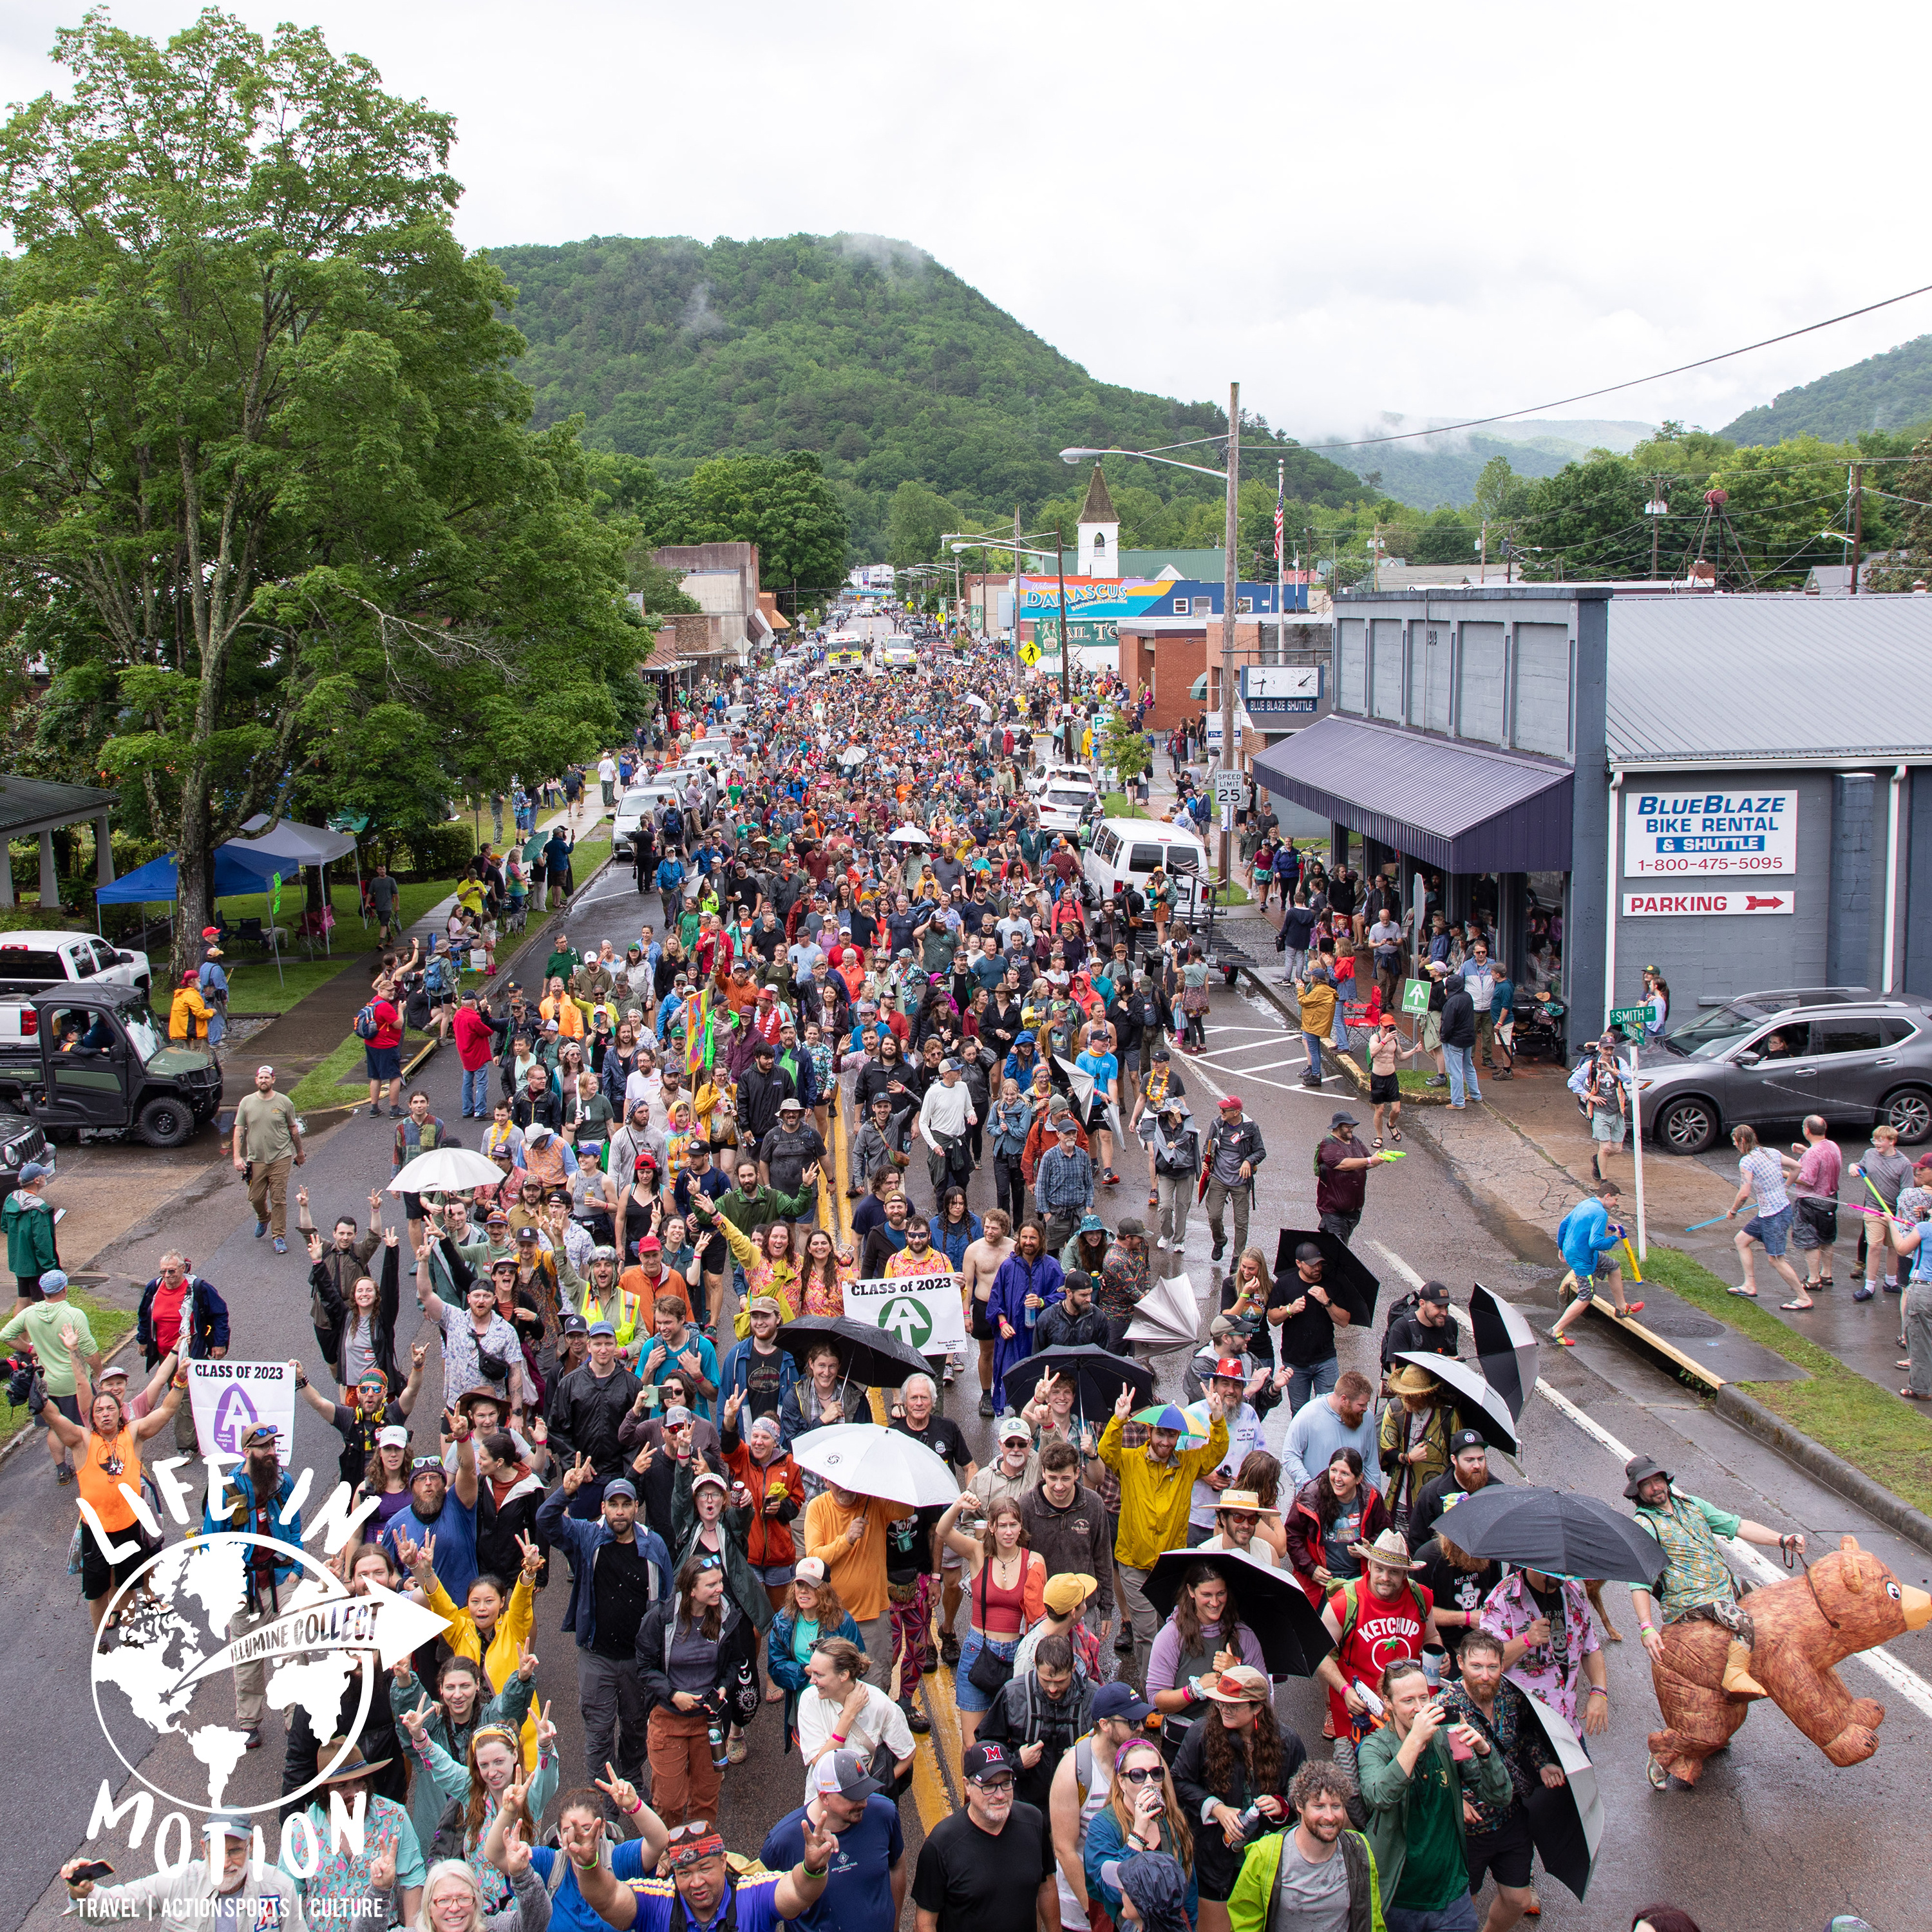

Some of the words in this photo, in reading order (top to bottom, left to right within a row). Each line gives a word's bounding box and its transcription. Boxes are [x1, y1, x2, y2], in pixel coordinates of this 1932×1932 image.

[1032, 582, 1060, 591] Welcom
[1027, 584, 1127, 609] DAMASCUS
[1250, 700, 1264, 711] BLUE
[1267, 700, 1285, 711] BLAZE
[1287, 700, 1312, 710] SHUTTLE
[1095, 717, 1104, 729] P
[1218, 789, 1240, 801] 25
[1646, 819, 1692, 833] BIKE
[1701, 817, 1778, 832] RENTAL
[1663, 838, 1674, 851] &
[1683, 837, 1759, 850] SHUTTLE
[1638, 857, 1783, 871] 1-800-475-5095
[1631, 896, 1727, 912] PARKING
[1616, 1009, 1645, 1023] SMITH
[851, 1282, 896, 1296] CLASS
[900, 1281, 913, 1293] of
[916, 1277, 951, 1291] 2023
[195, 1364, 233, 1378] CLASS
[236, 1365, 252, 1378] OF
[254, 1367, 283, 1379] 2023
[1358, 1617, 1420, 1642] KETCHUP
[982, 1745, 1004, 1763] M
